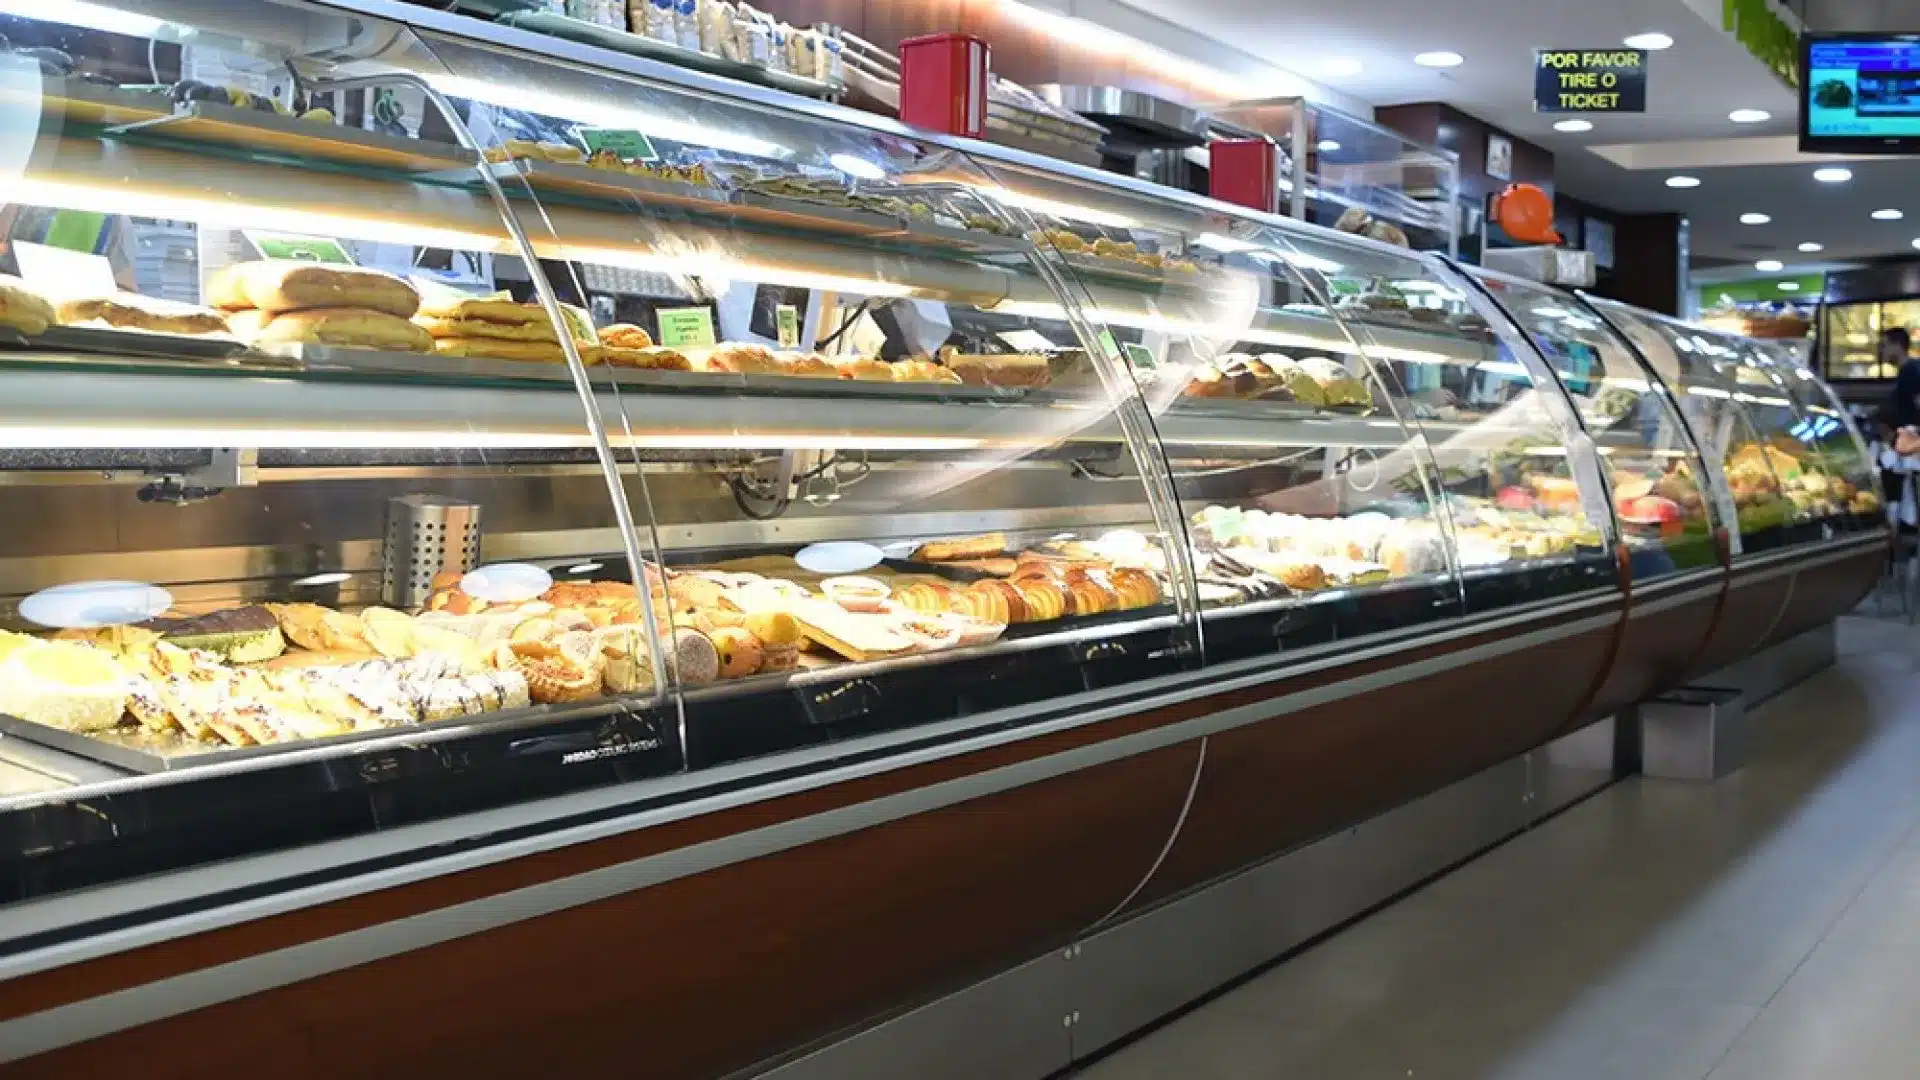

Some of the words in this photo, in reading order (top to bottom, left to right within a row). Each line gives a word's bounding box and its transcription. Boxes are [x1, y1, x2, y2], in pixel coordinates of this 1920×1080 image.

[1541, 52, 1578, 68] POR
[1582, 52, 1640, 67] FAVOR
[1559, 72, 1597, 88] TIRE
[1601, 72, 1616, 88] O
[1559, 93, 1620, 108] TICKET
